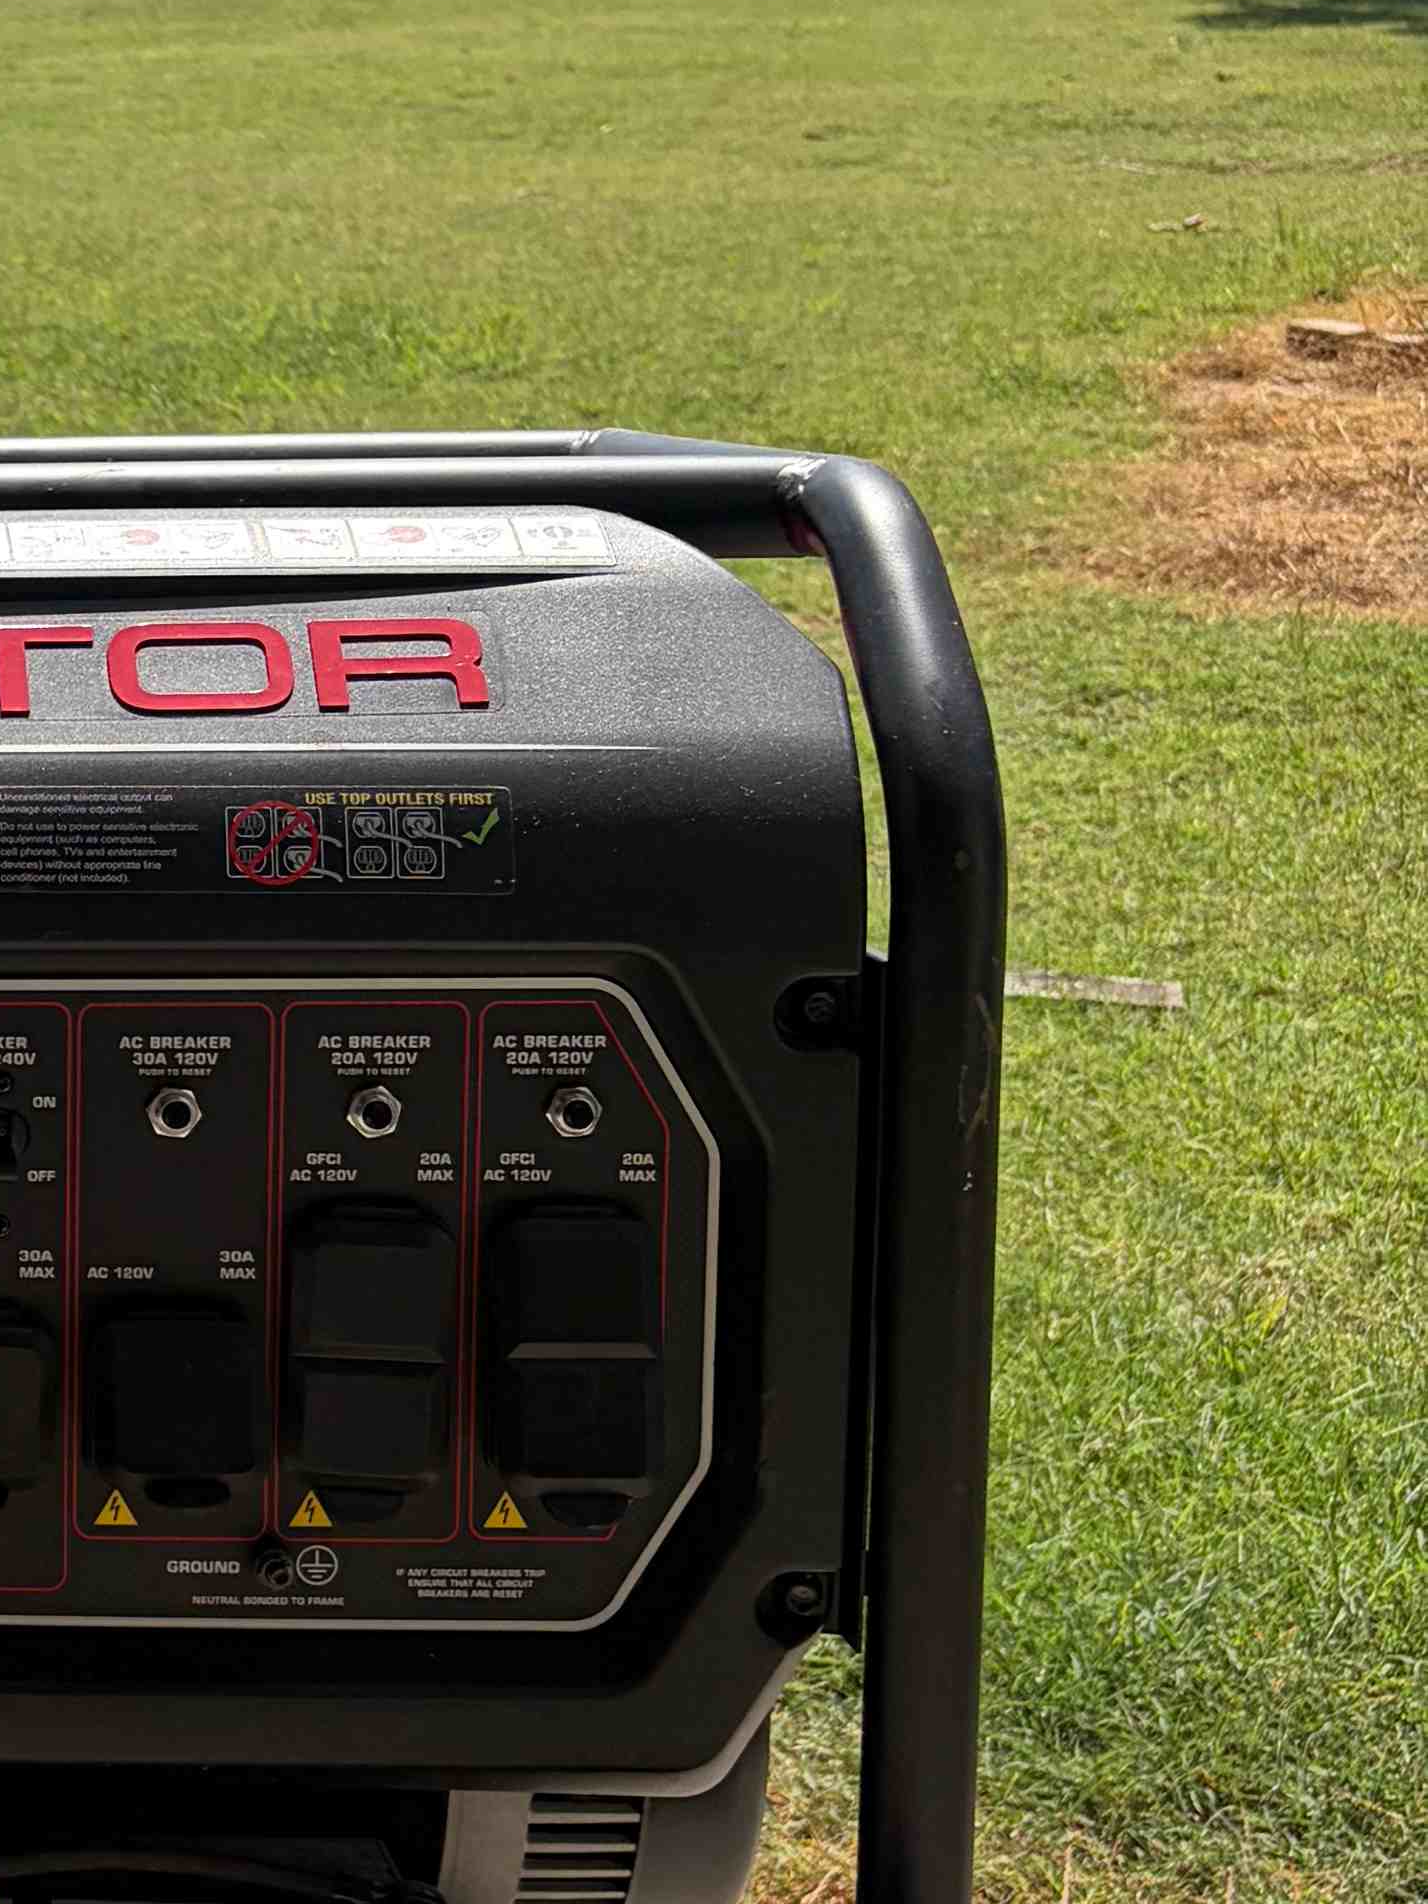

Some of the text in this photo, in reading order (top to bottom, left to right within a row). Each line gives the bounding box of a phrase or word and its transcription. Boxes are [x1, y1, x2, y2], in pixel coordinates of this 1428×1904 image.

[120, 793, 152, 803] output
[154, 794, 173, 802] can
[305, 792, 493, 806] USE TOP OUTLETS FIRST
[0, 804, 40, 815] damage
[42, 804, 88, 814] sensitive
[119, 1036, 232, 1049] AC BREAKER
[318, 1035, 432, 1049] AC BREAKER
[492, 1035, 607, 1048] AC BREAKER
[132, 1052, 219, 1065] 30A 120V
[331, 1052, 418, 1065] 20A 120V
[506, 1051, 594, 1065] 20A 120V
[32, 1096, 56, 1108] ON
[305, 1153, 341, 1165] GFCI
[420, 1153, 452, 1165] 20A
[499, 1153, 535, 1165] GFCI
[622, 1153, 654, 1165] 20A
[27, 1169, 56, 1182] OFF
[289, 1169, 358, 1182] AC 120V
[417, 1169, 454, 1182] MAX
[483, 1169, 552, 1182] AC 120V
[619, 1169, 656, 1182] MAX
[18, 1250, 53, 1263] 30A
[219, 1250, 254, 1263] 30A
[18, 1266, 55, 1279] MAX
[87, 1266, 154, 1280] AC 120V
[219, 1266, 256, 1280] MAX
[166, 1560, 241, 1574] GROUND
[407, 1568, 429, 1577] ANY
[191, 1595, 345, 1607] NEUTRAL BONDED TO FRAME
